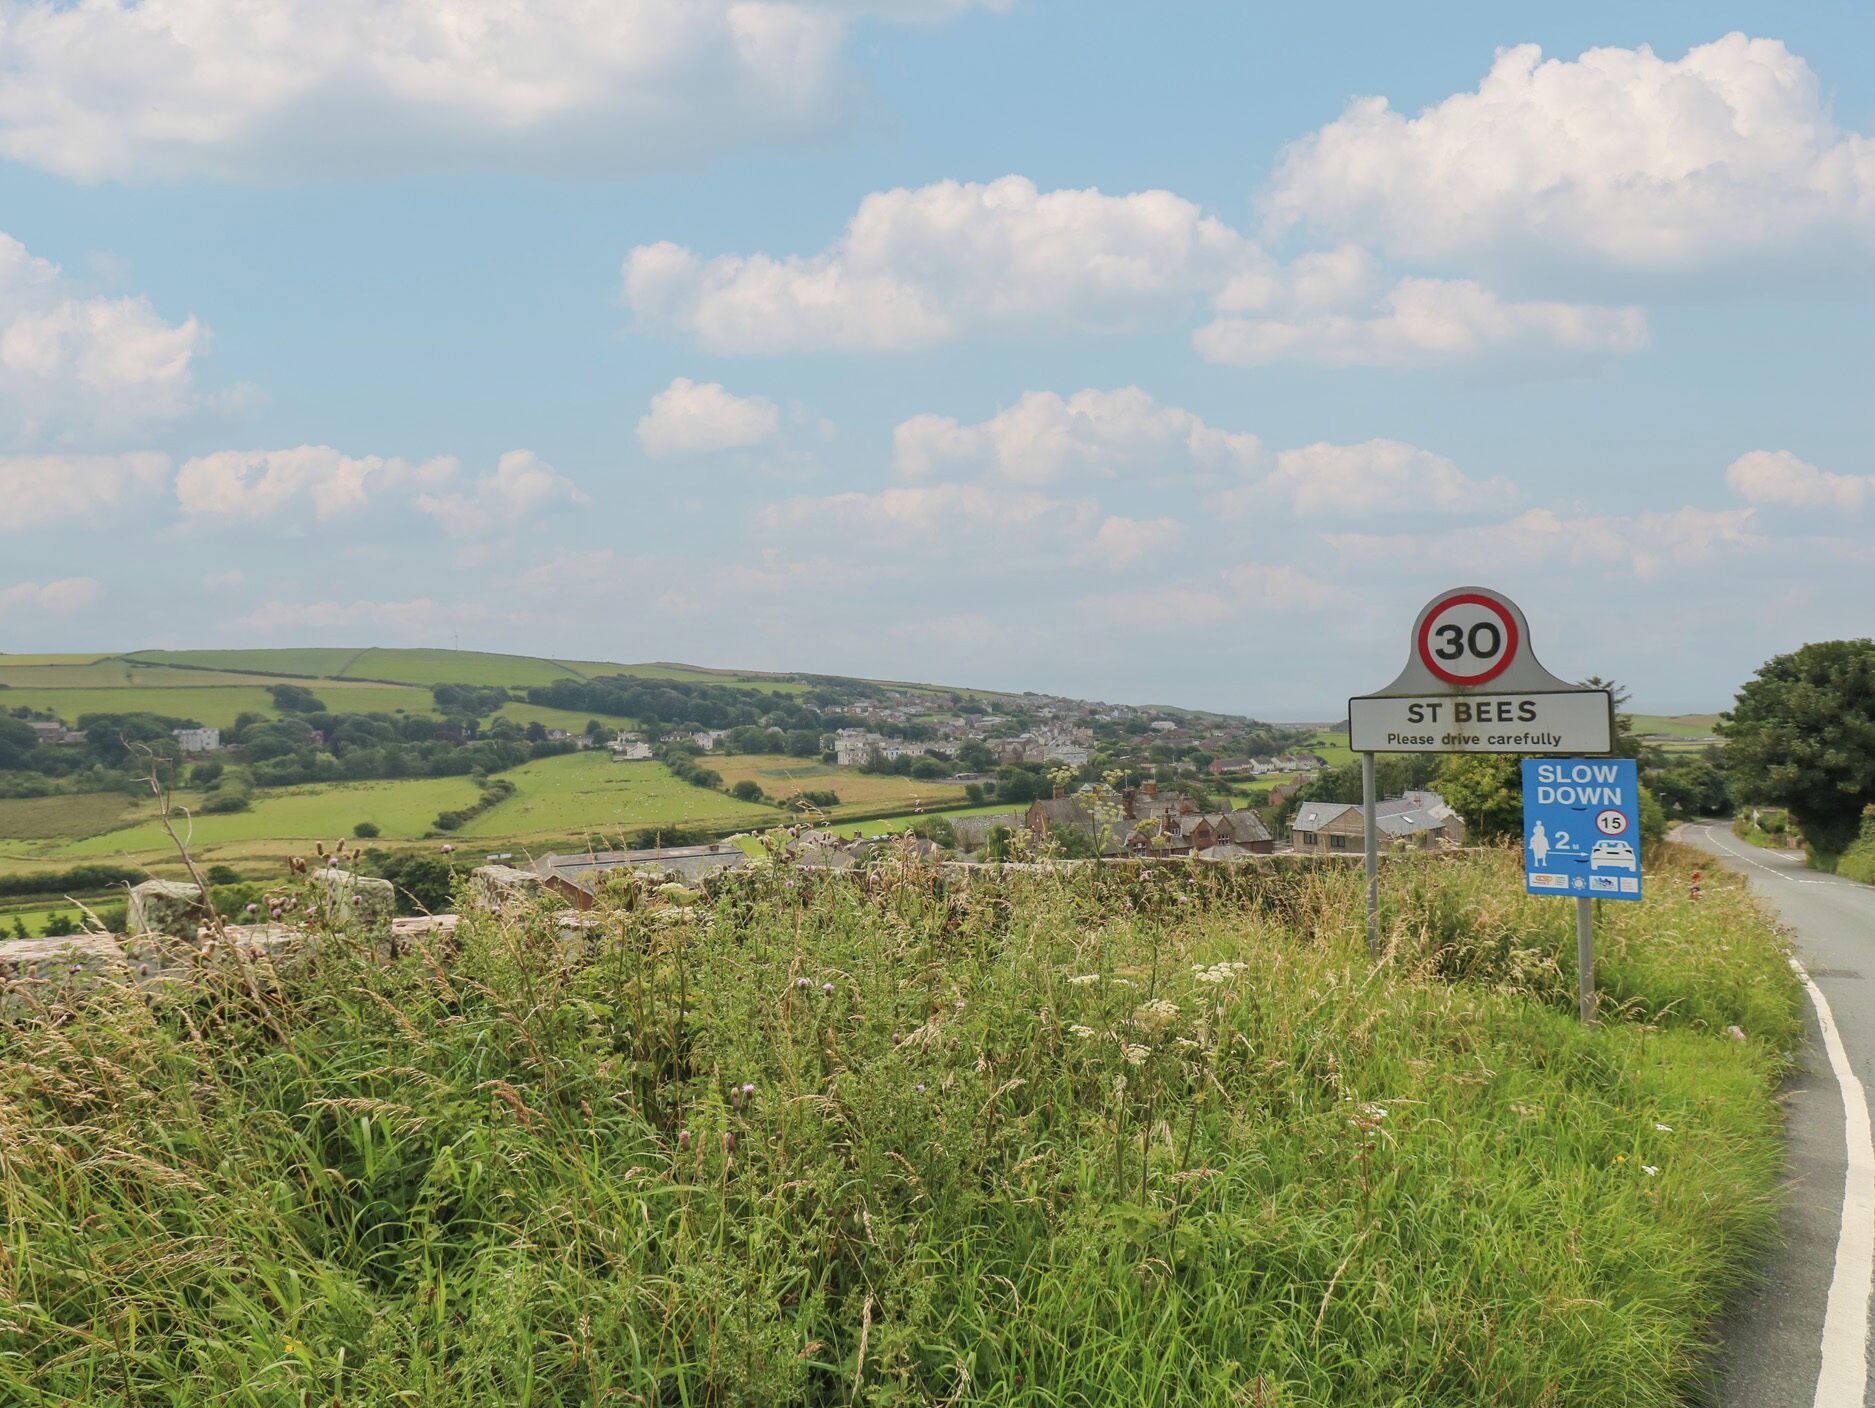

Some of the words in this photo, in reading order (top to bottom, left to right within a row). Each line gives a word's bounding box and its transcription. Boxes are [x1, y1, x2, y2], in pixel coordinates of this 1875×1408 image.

[1434, 622, 1501, 660] 30
[1407, 703, 1442, 723] ST
[1454, 701, 1537, 722] BEES
[1387, 733, 1434, 745] Please
[1441, 732, 1480, 745] drive
[1487, 732, 1562, 748] carefully
[1538, 765, 1618, 783] SLOW
[1537, 786, 1622, 805] DOWN
[1601, 817, 1621, 829] 15
[1554, 831, 1570, 850] 2
